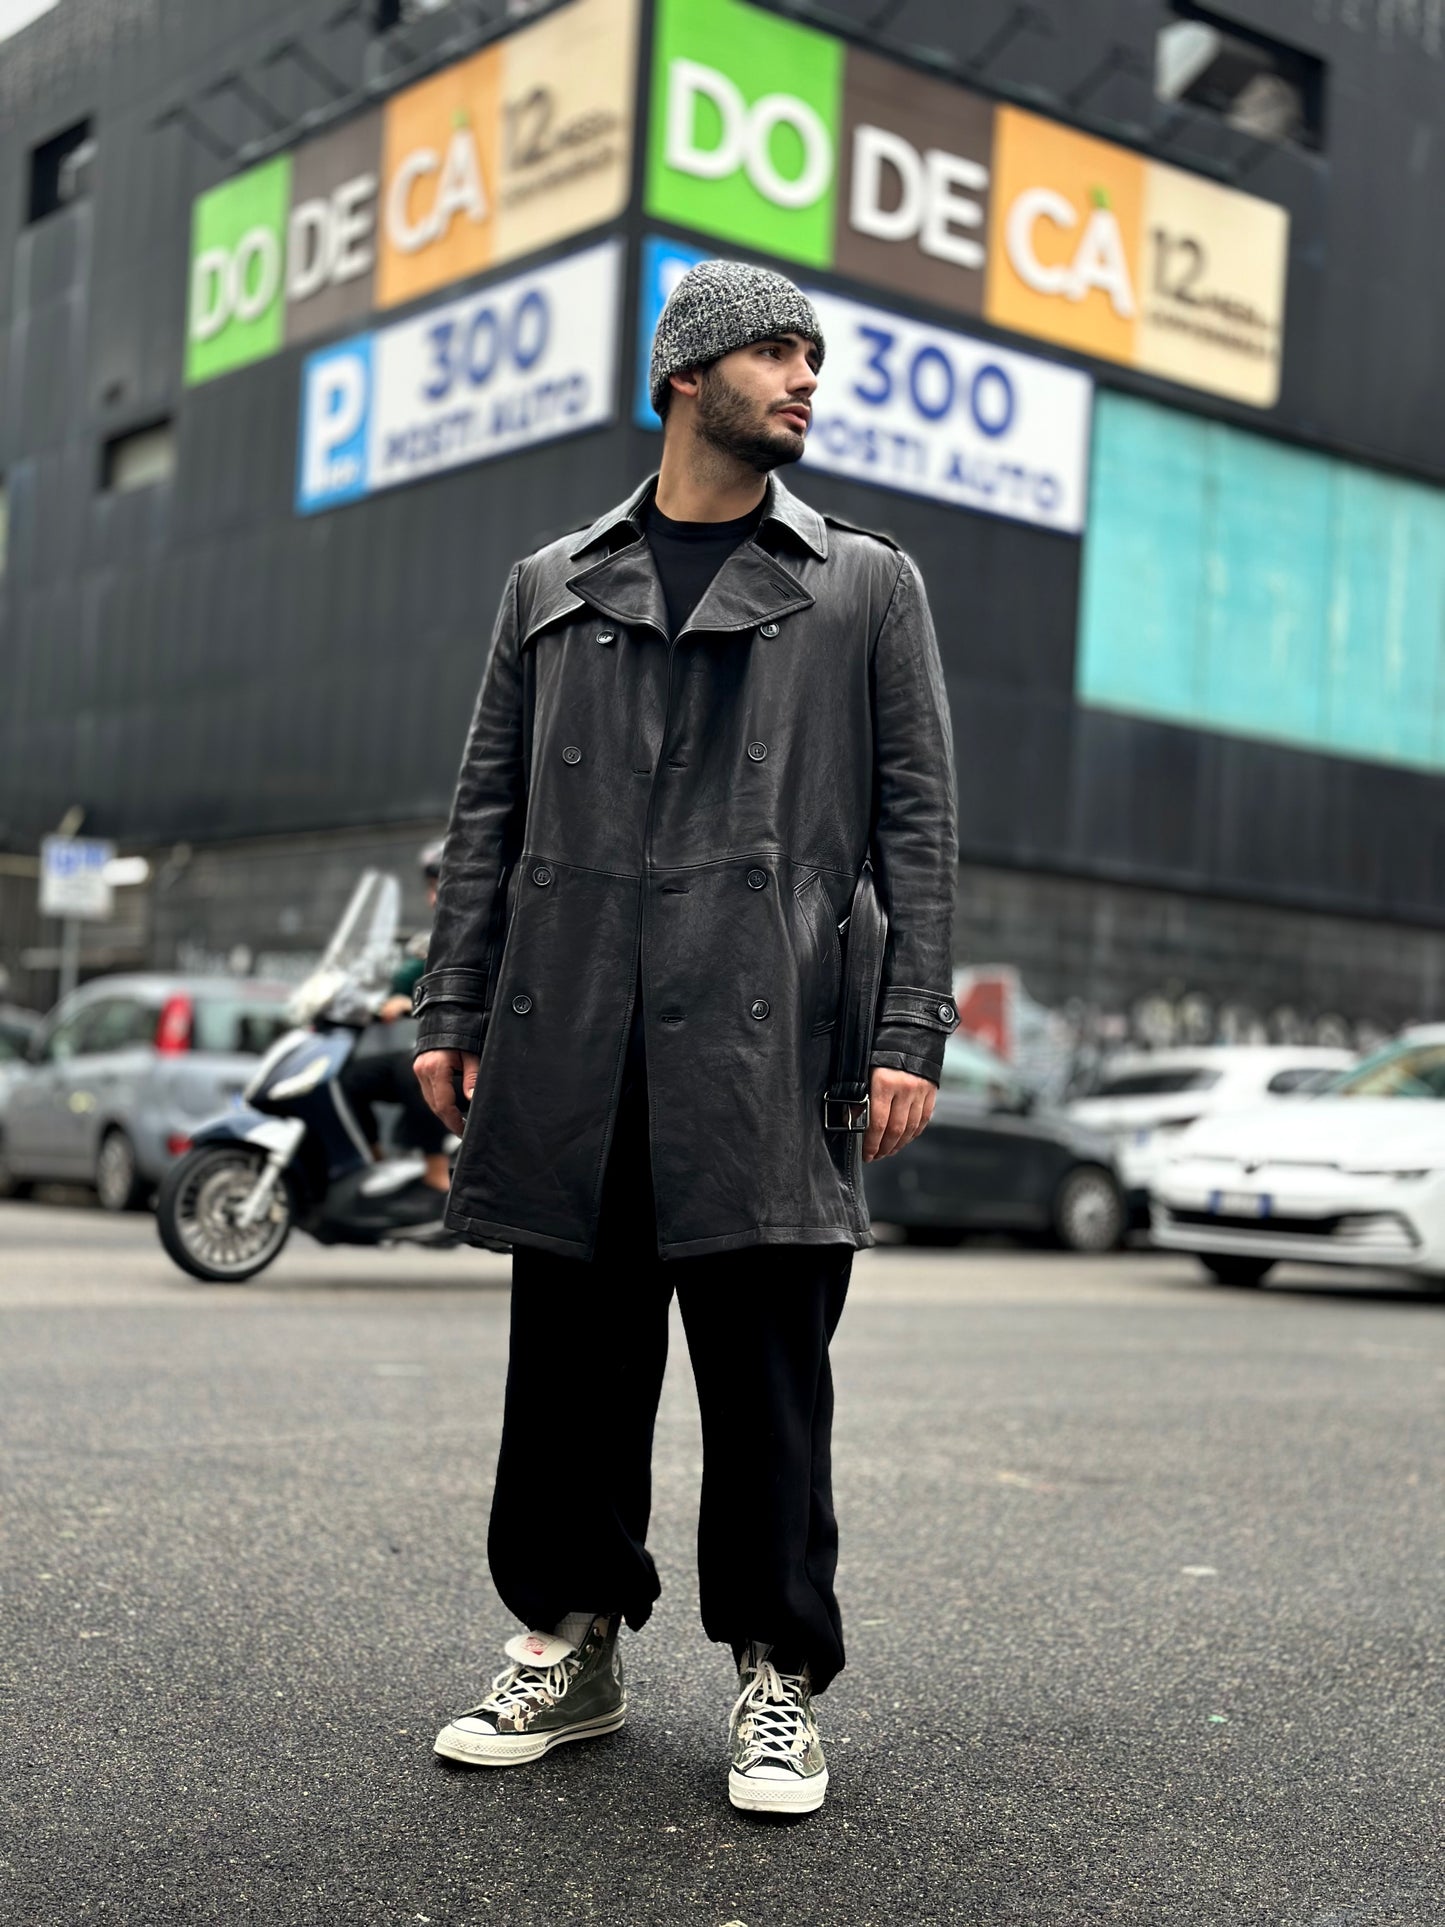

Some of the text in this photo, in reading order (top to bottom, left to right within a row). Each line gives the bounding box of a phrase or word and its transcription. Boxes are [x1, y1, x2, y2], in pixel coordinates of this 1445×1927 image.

[421, 287, 550, 403] 300
[853, 324, 1016, 438] 300
[945, 449, 1062, 511] AUTO
